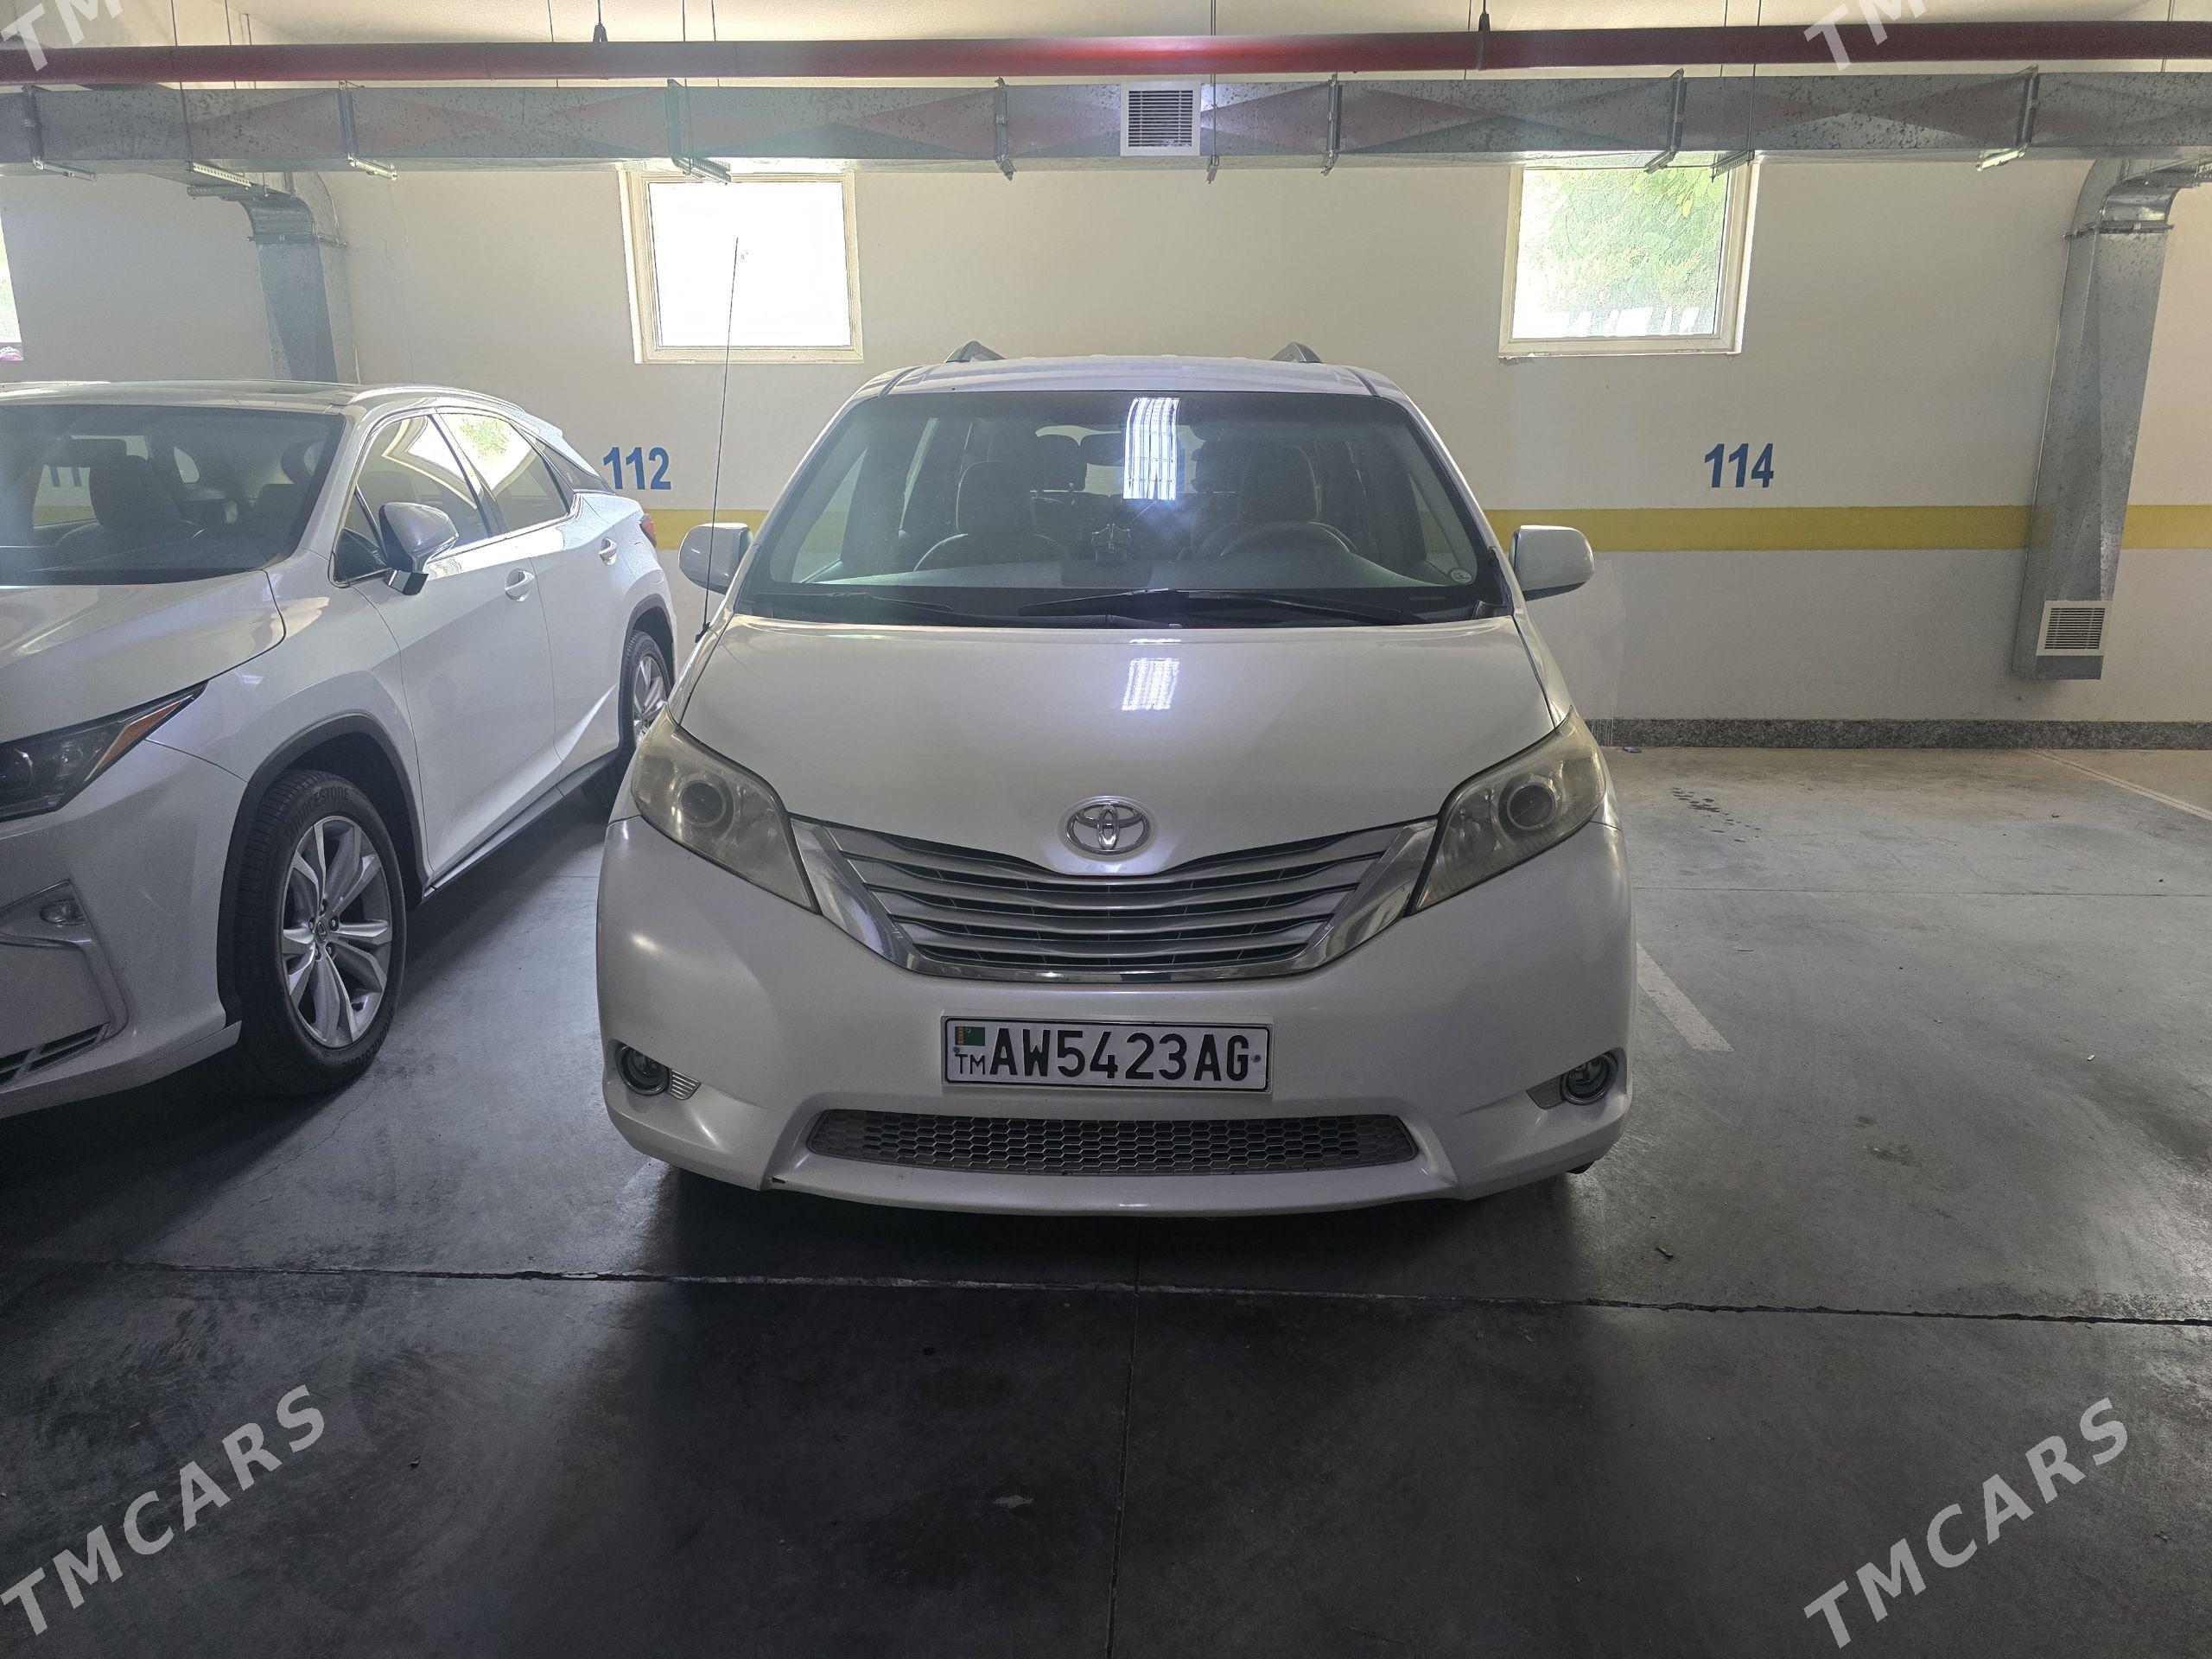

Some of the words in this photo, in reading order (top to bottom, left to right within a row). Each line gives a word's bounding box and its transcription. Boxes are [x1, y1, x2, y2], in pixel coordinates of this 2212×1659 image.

[602, 446, 672, 490] 112
[1704, 443, 1774, 488] 114
[954, 1053, 986, 1075] TM
[989, 1027, 1249, 1082] AW5423AG
